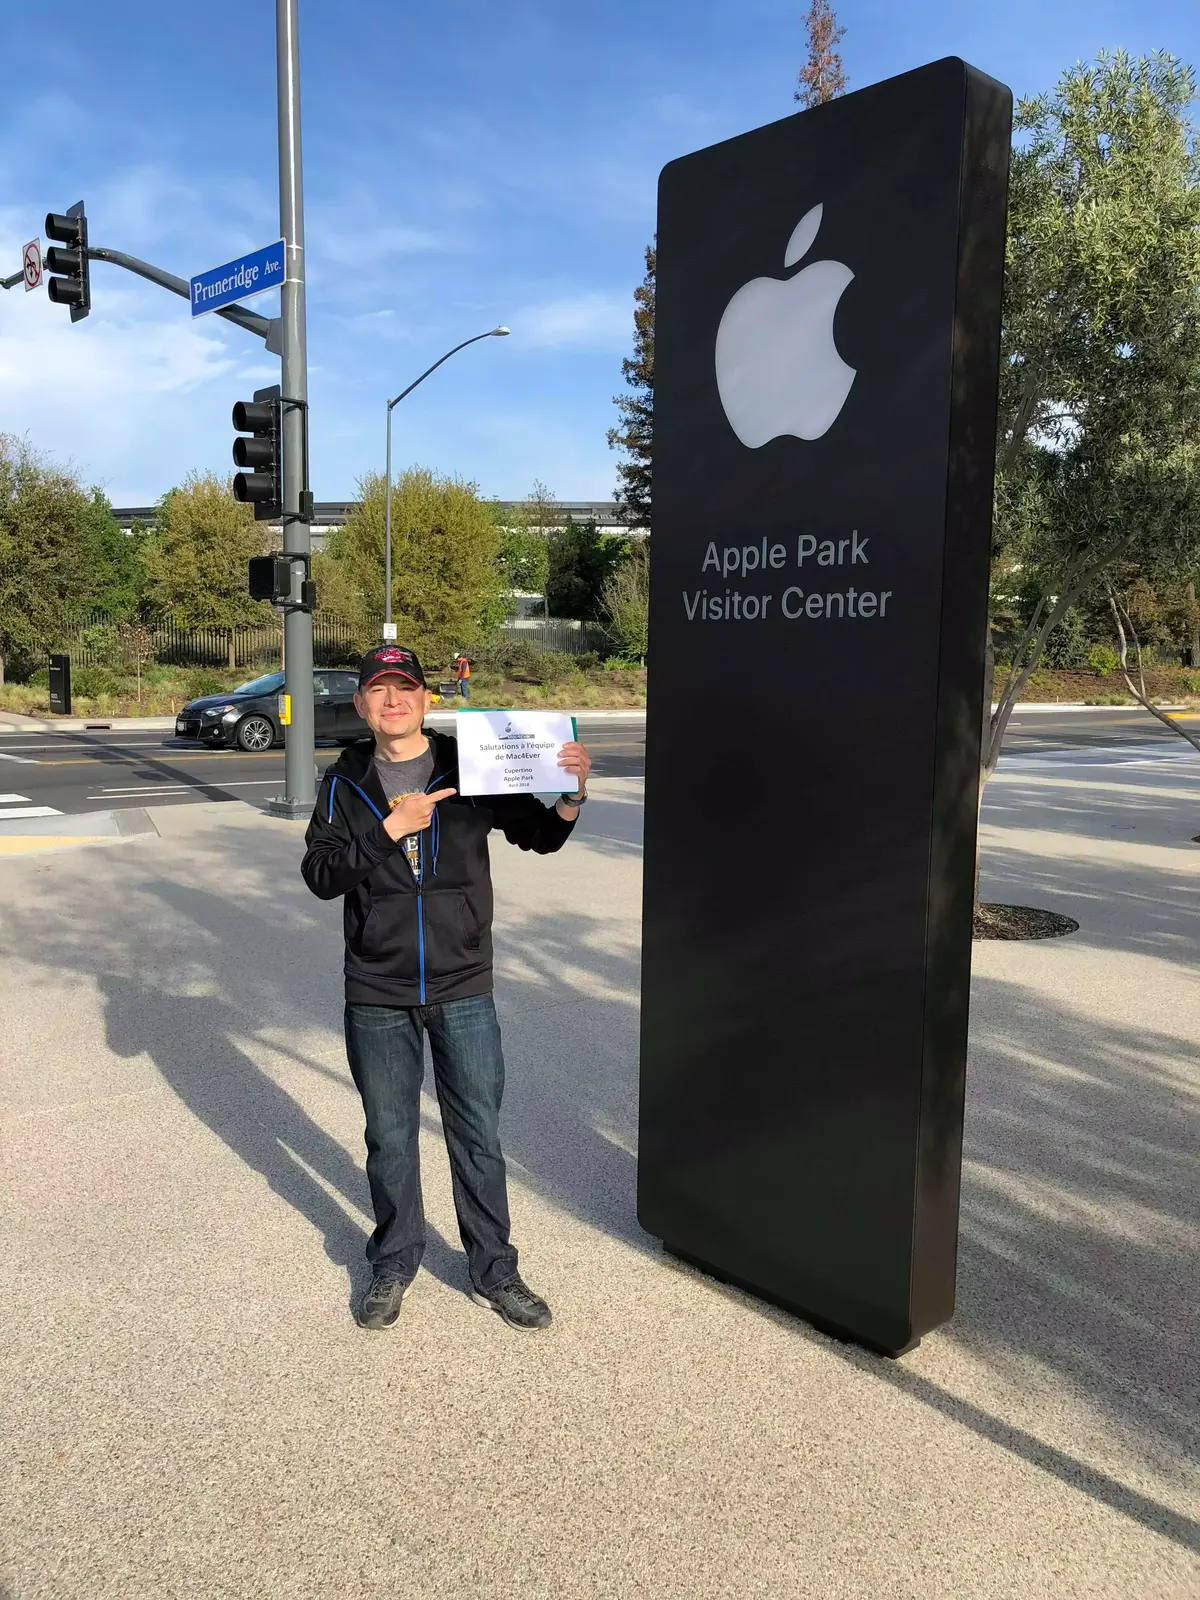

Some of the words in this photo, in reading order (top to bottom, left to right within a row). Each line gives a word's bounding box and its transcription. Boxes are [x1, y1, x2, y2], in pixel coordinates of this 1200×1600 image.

[193, 263, 259, 304] Pruneridge
[263, 260, 282, 276] Ave.
[701, 536, 787, 578] Apple
[797, 529, 869, 567] Park
[682, 588, 772, 620] Visitor
[781, 586, 892, 619] Center
[479, 743, 519, 751] Salutations
[520, 742, 526, 750] à
[505, 752, 540, 760] Mac4Ever
